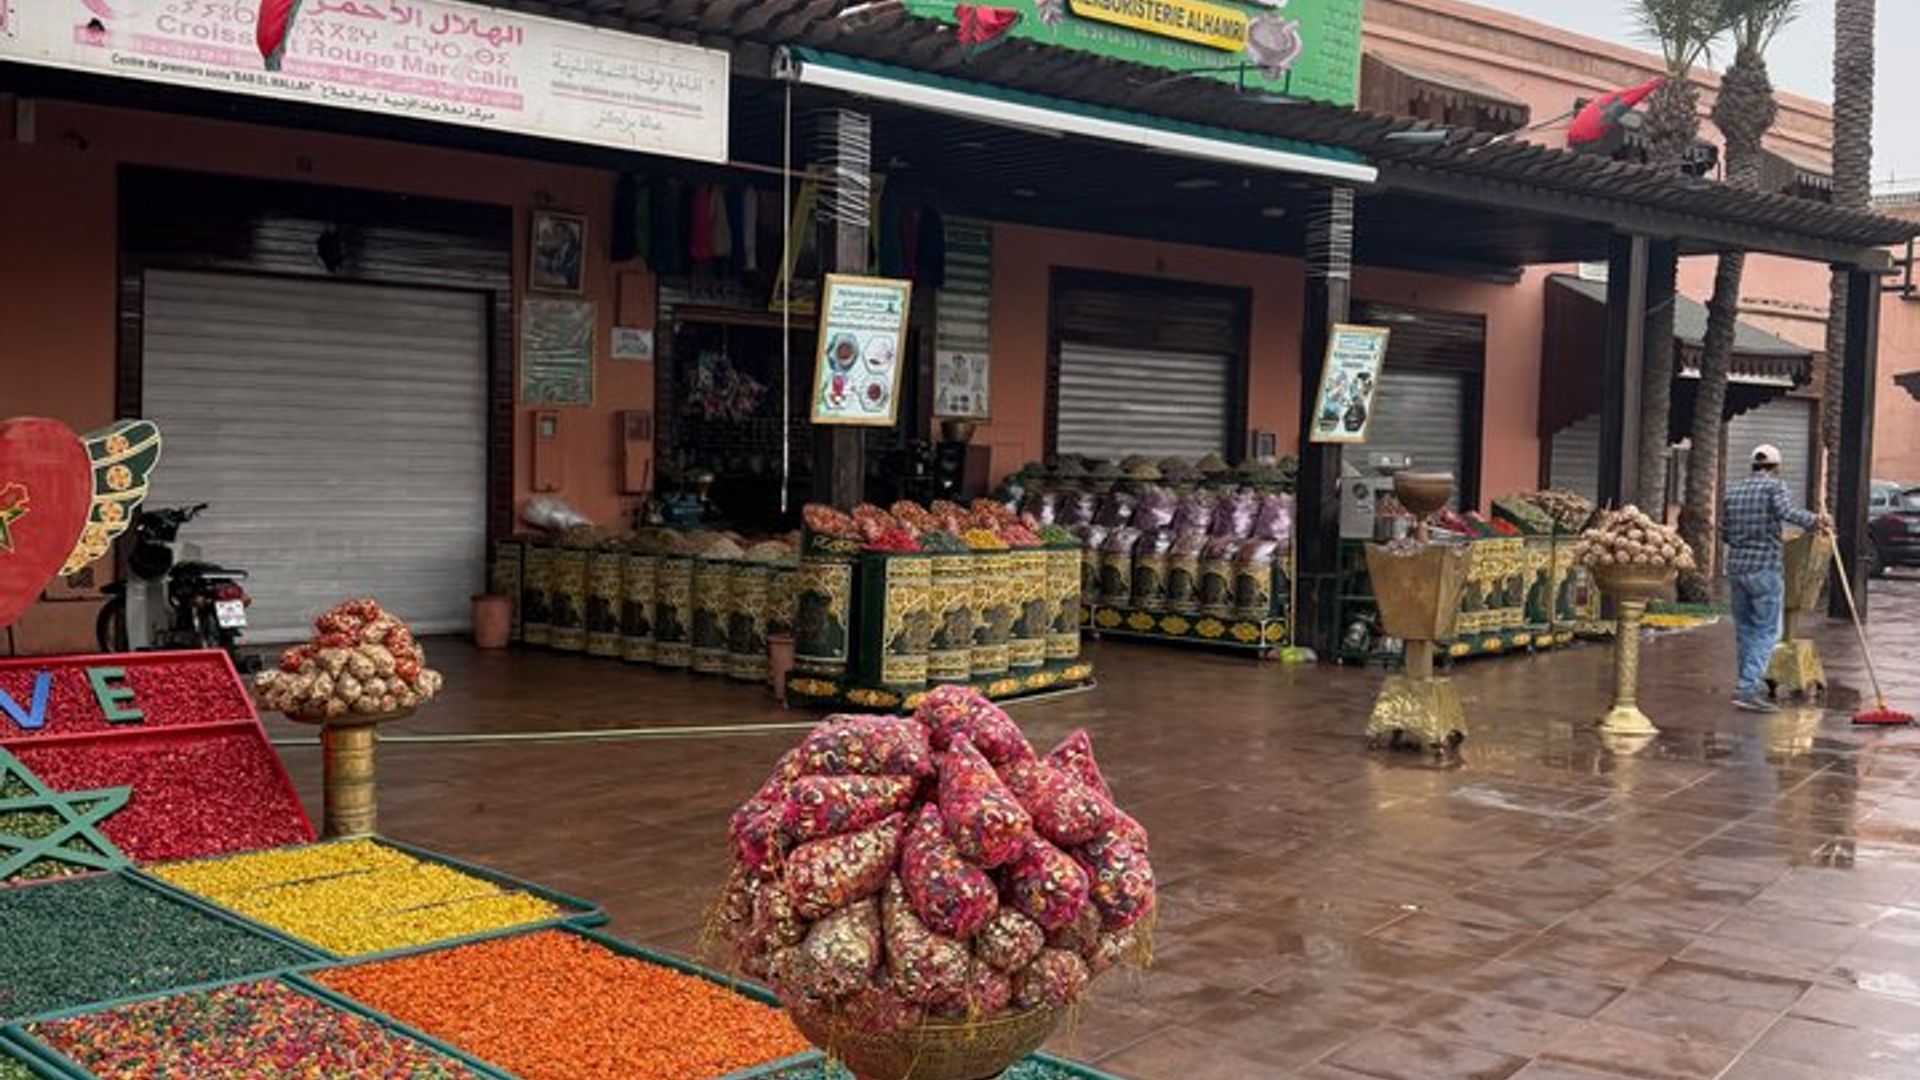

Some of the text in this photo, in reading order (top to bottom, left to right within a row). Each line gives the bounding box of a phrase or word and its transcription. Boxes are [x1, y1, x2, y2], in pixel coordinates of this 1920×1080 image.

[156, 14, 298, 54] Croisst
[308, 38, 395, 68] Rouge
[430, 14, 523, 47] الهلال
[112, 52, 145, 66] Centre
